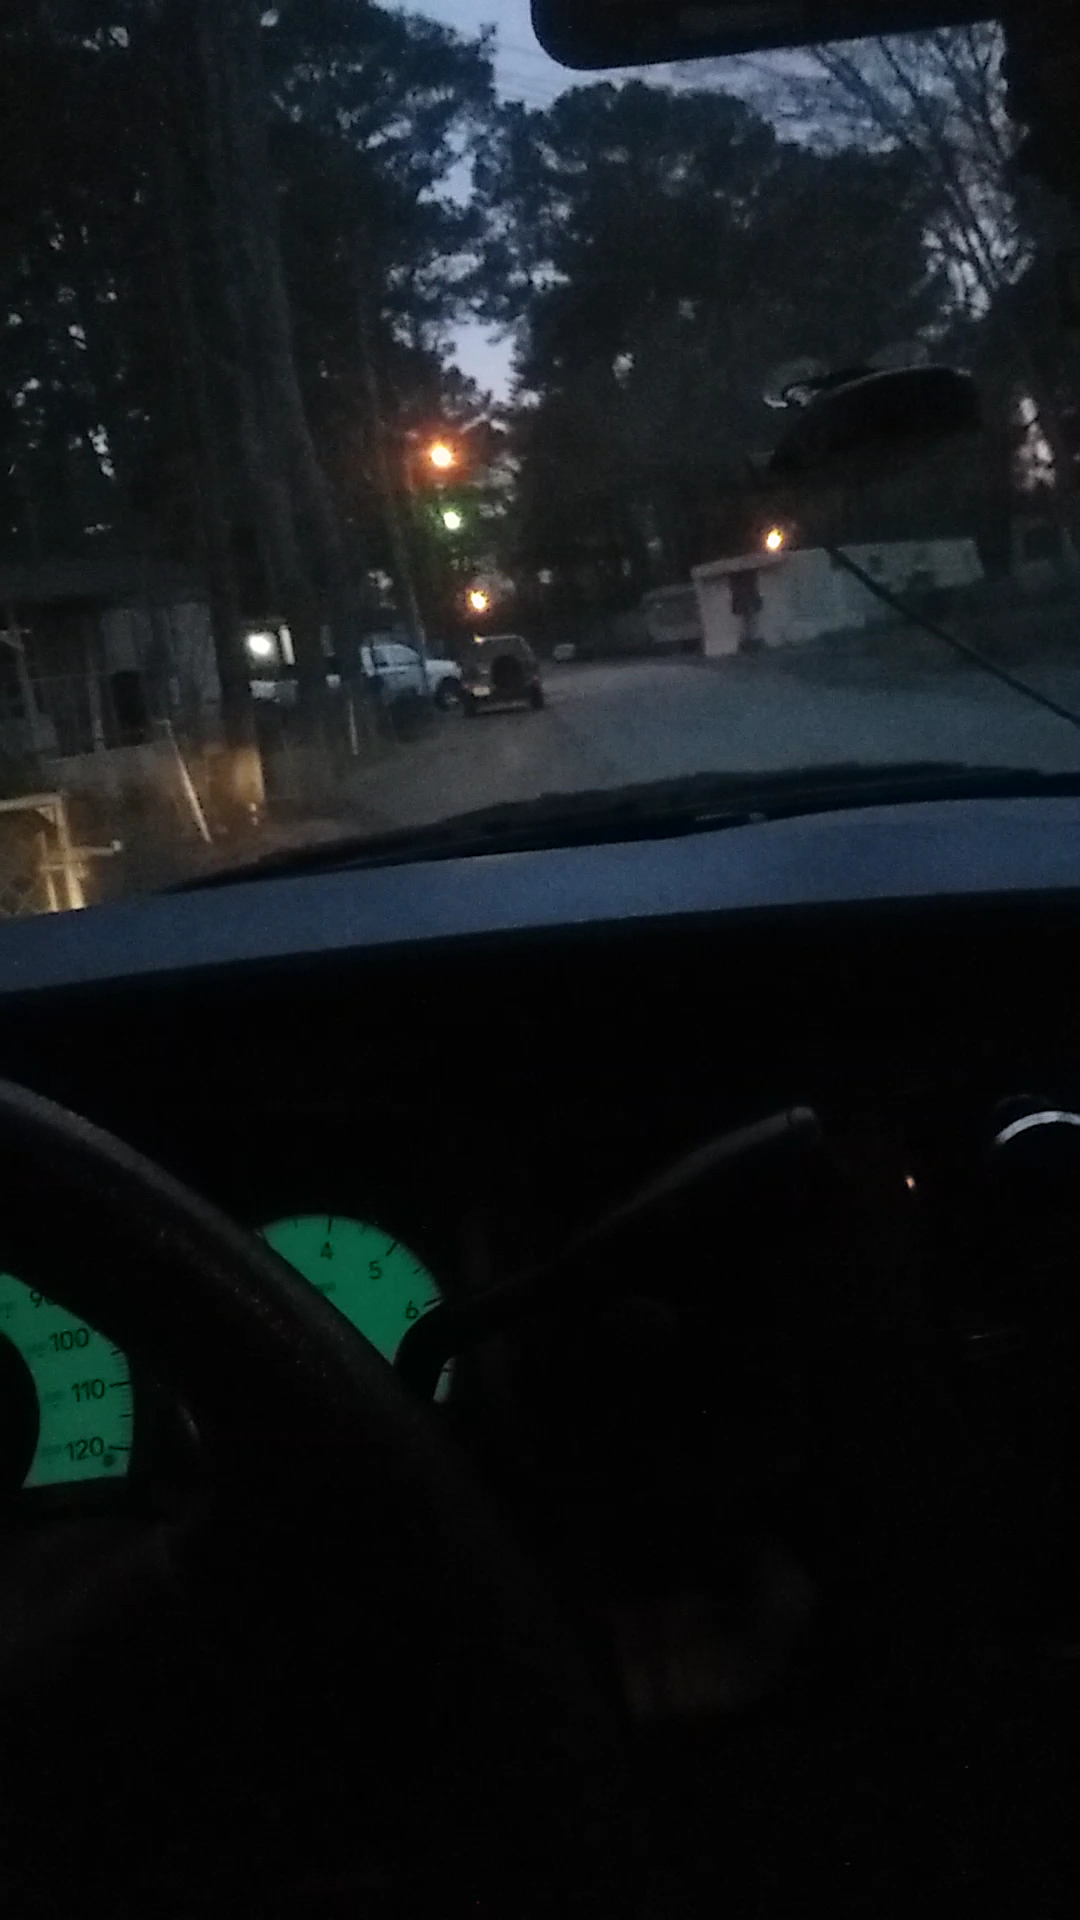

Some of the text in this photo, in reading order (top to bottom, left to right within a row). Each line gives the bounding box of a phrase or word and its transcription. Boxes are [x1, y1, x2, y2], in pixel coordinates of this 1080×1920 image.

[320, 1241, 334, 1260] 4
[368, 1260, 383, 1280] 5
[405, 1300, 419, 1319] 6
[49, 1328, 89, 1352] 100
[71, 1379, 105, 1402] 110
[64, 1436, 104, 1461] 120
